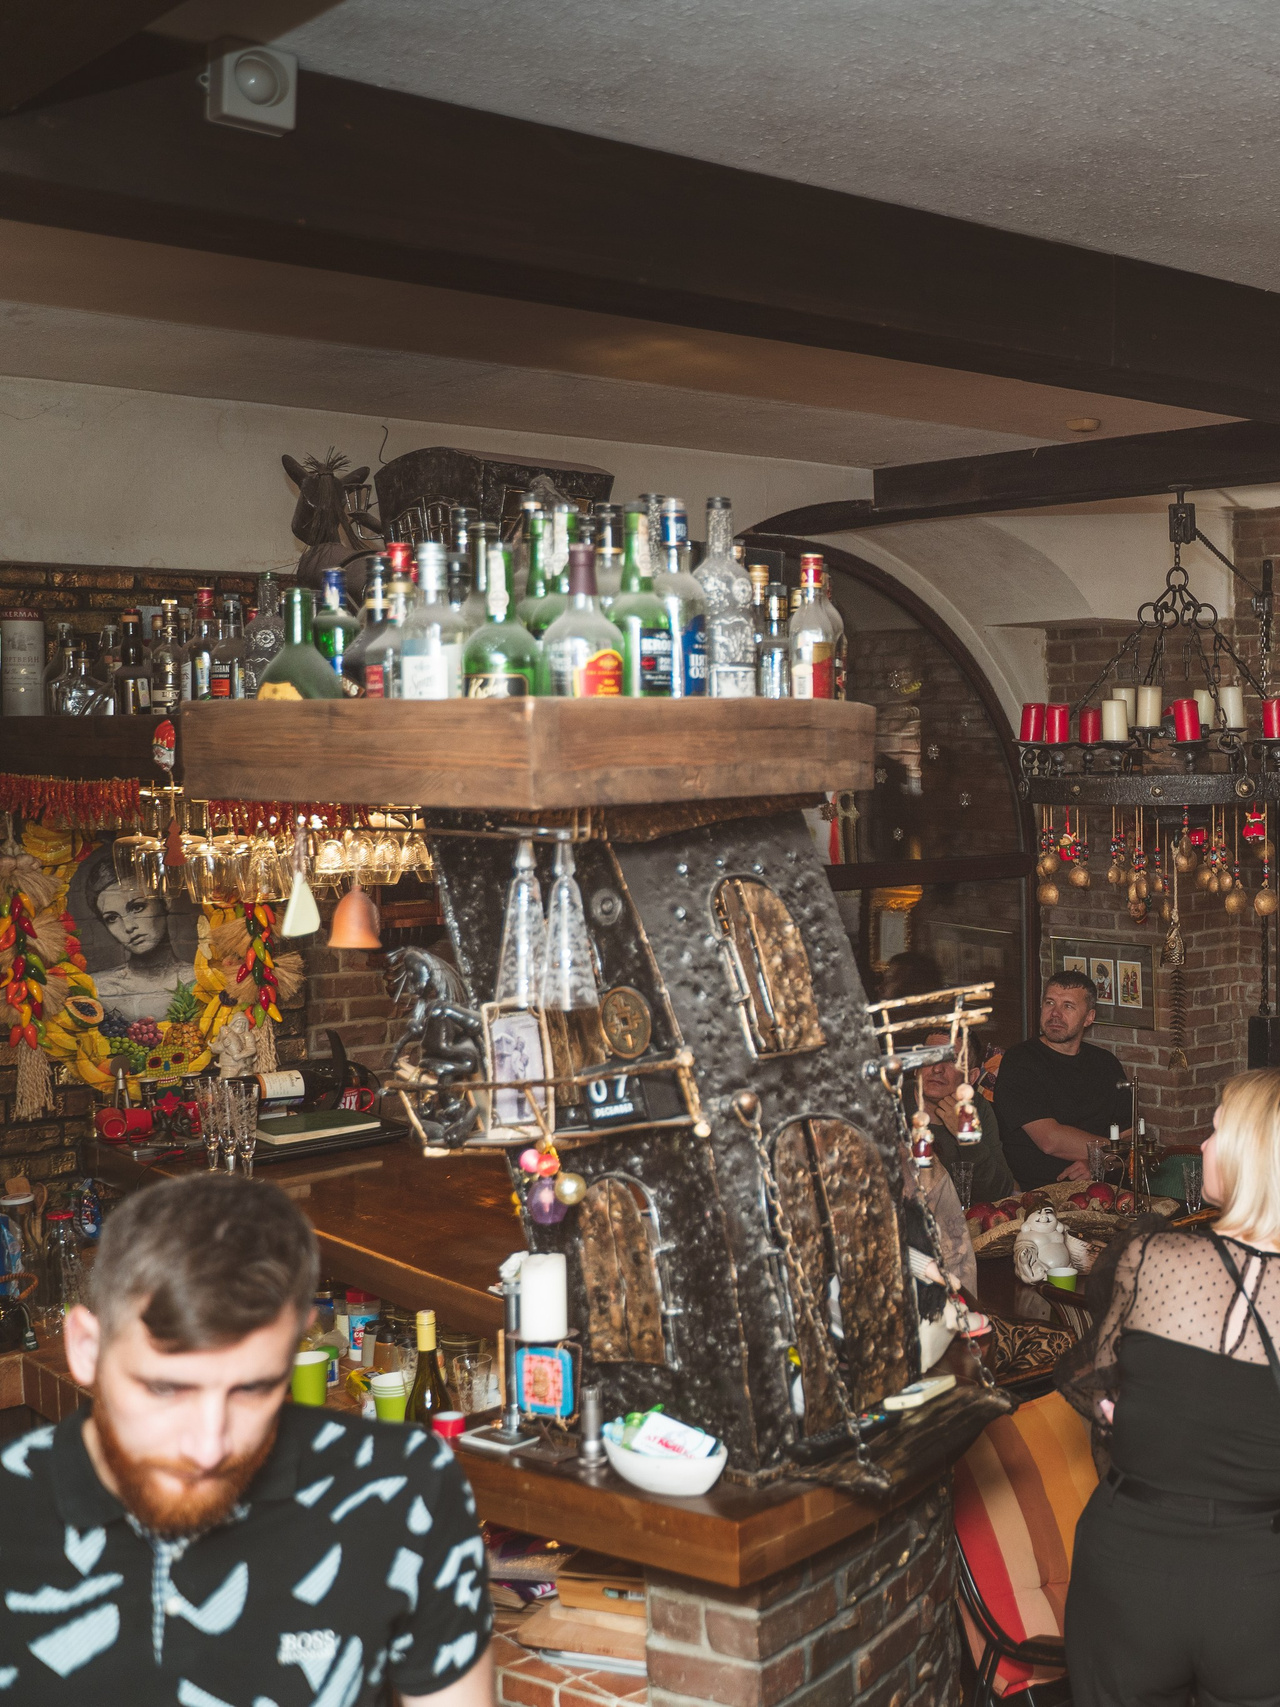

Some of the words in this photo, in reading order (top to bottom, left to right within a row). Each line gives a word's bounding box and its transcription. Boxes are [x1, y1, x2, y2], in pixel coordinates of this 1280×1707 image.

[2, 655, 40, 663] ОРТВЕЙН
[590, 1074, 628, 1104] 07
[280, 1628, 337, 1650] BOSS
